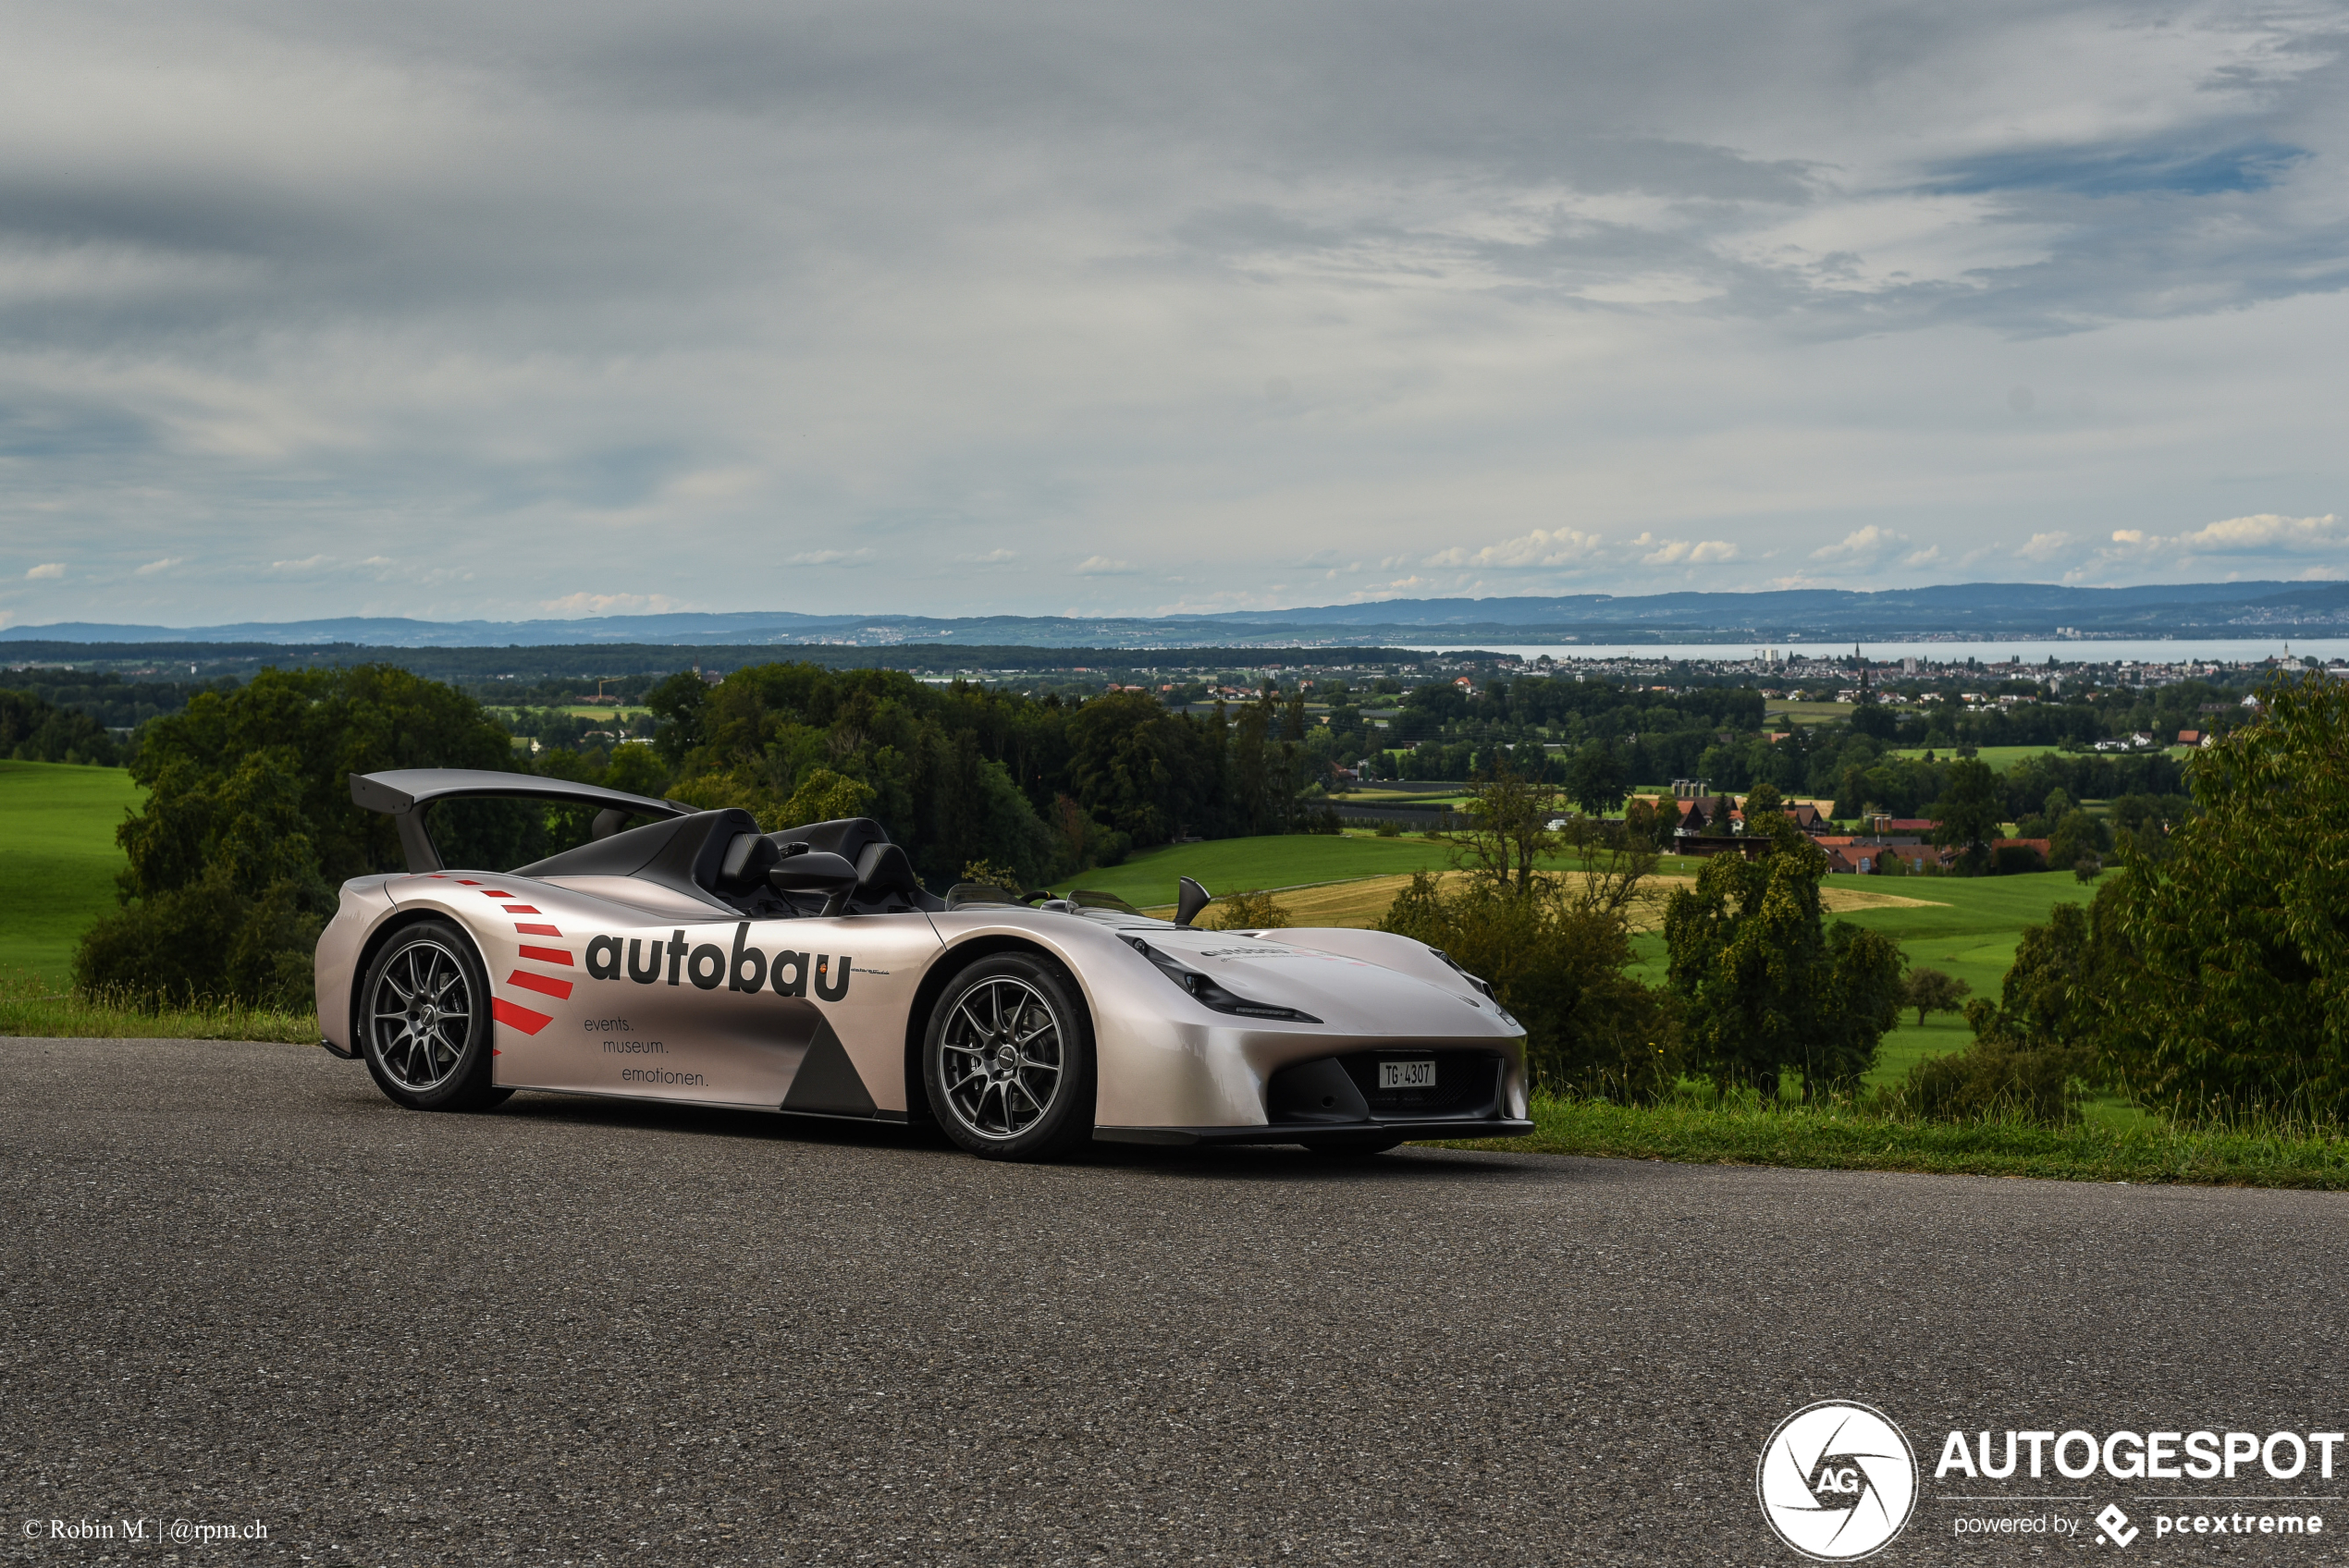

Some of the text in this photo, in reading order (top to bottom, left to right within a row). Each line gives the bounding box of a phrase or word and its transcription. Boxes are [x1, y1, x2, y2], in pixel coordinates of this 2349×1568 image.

[584, 921, 852, 1002] autobau
[584, 1016, 634, 1032] events.
[603, 1040, 670, 1054] museum.
[621, 1067, 709, 1087] emotionen.
